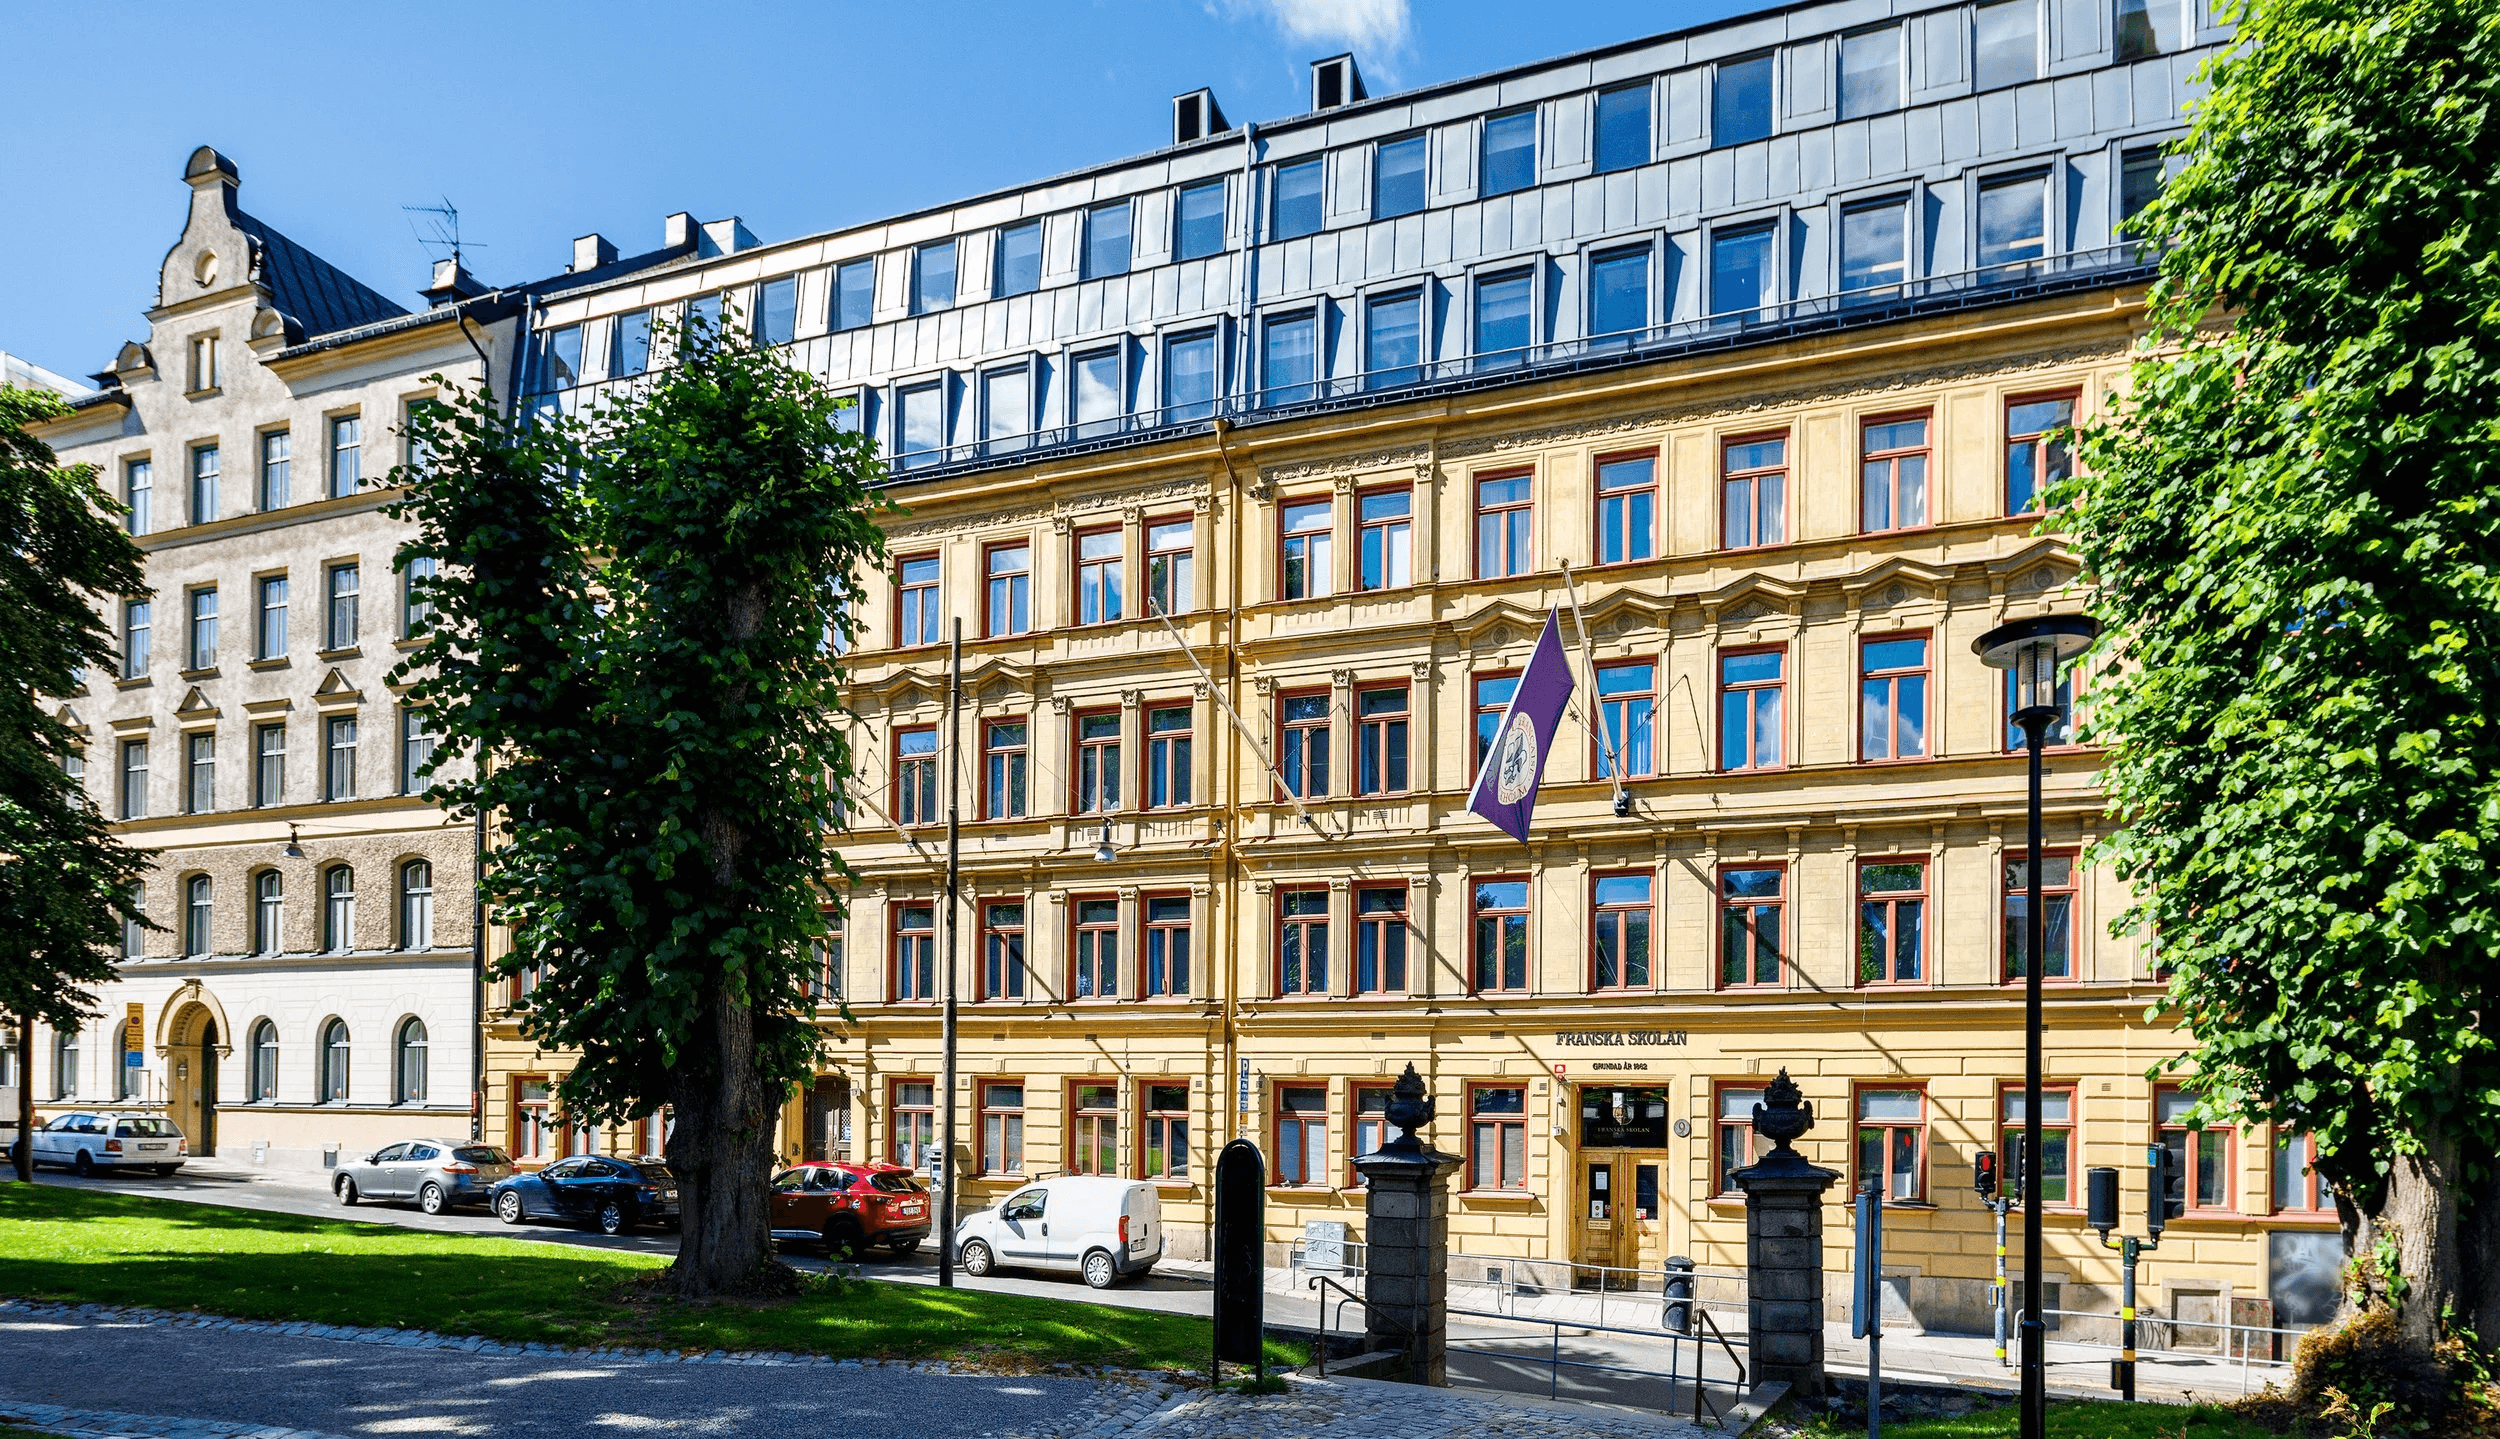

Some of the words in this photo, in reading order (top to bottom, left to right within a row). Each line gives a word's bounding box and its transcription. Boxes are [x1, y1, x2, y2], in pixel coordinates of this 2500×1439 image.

[1555, 1031, 1625, 1046] FRANSKA
[1628, 1030, 1687, 1046] SKOLAN
[1592, 1062, 1622, 1071] GRUNDAD
[1623, 1061, 1633, 1070] ÅR
[1633, 1062, 1648, 1071] 1862
[1678, 1121, 1686, 1134] 9
